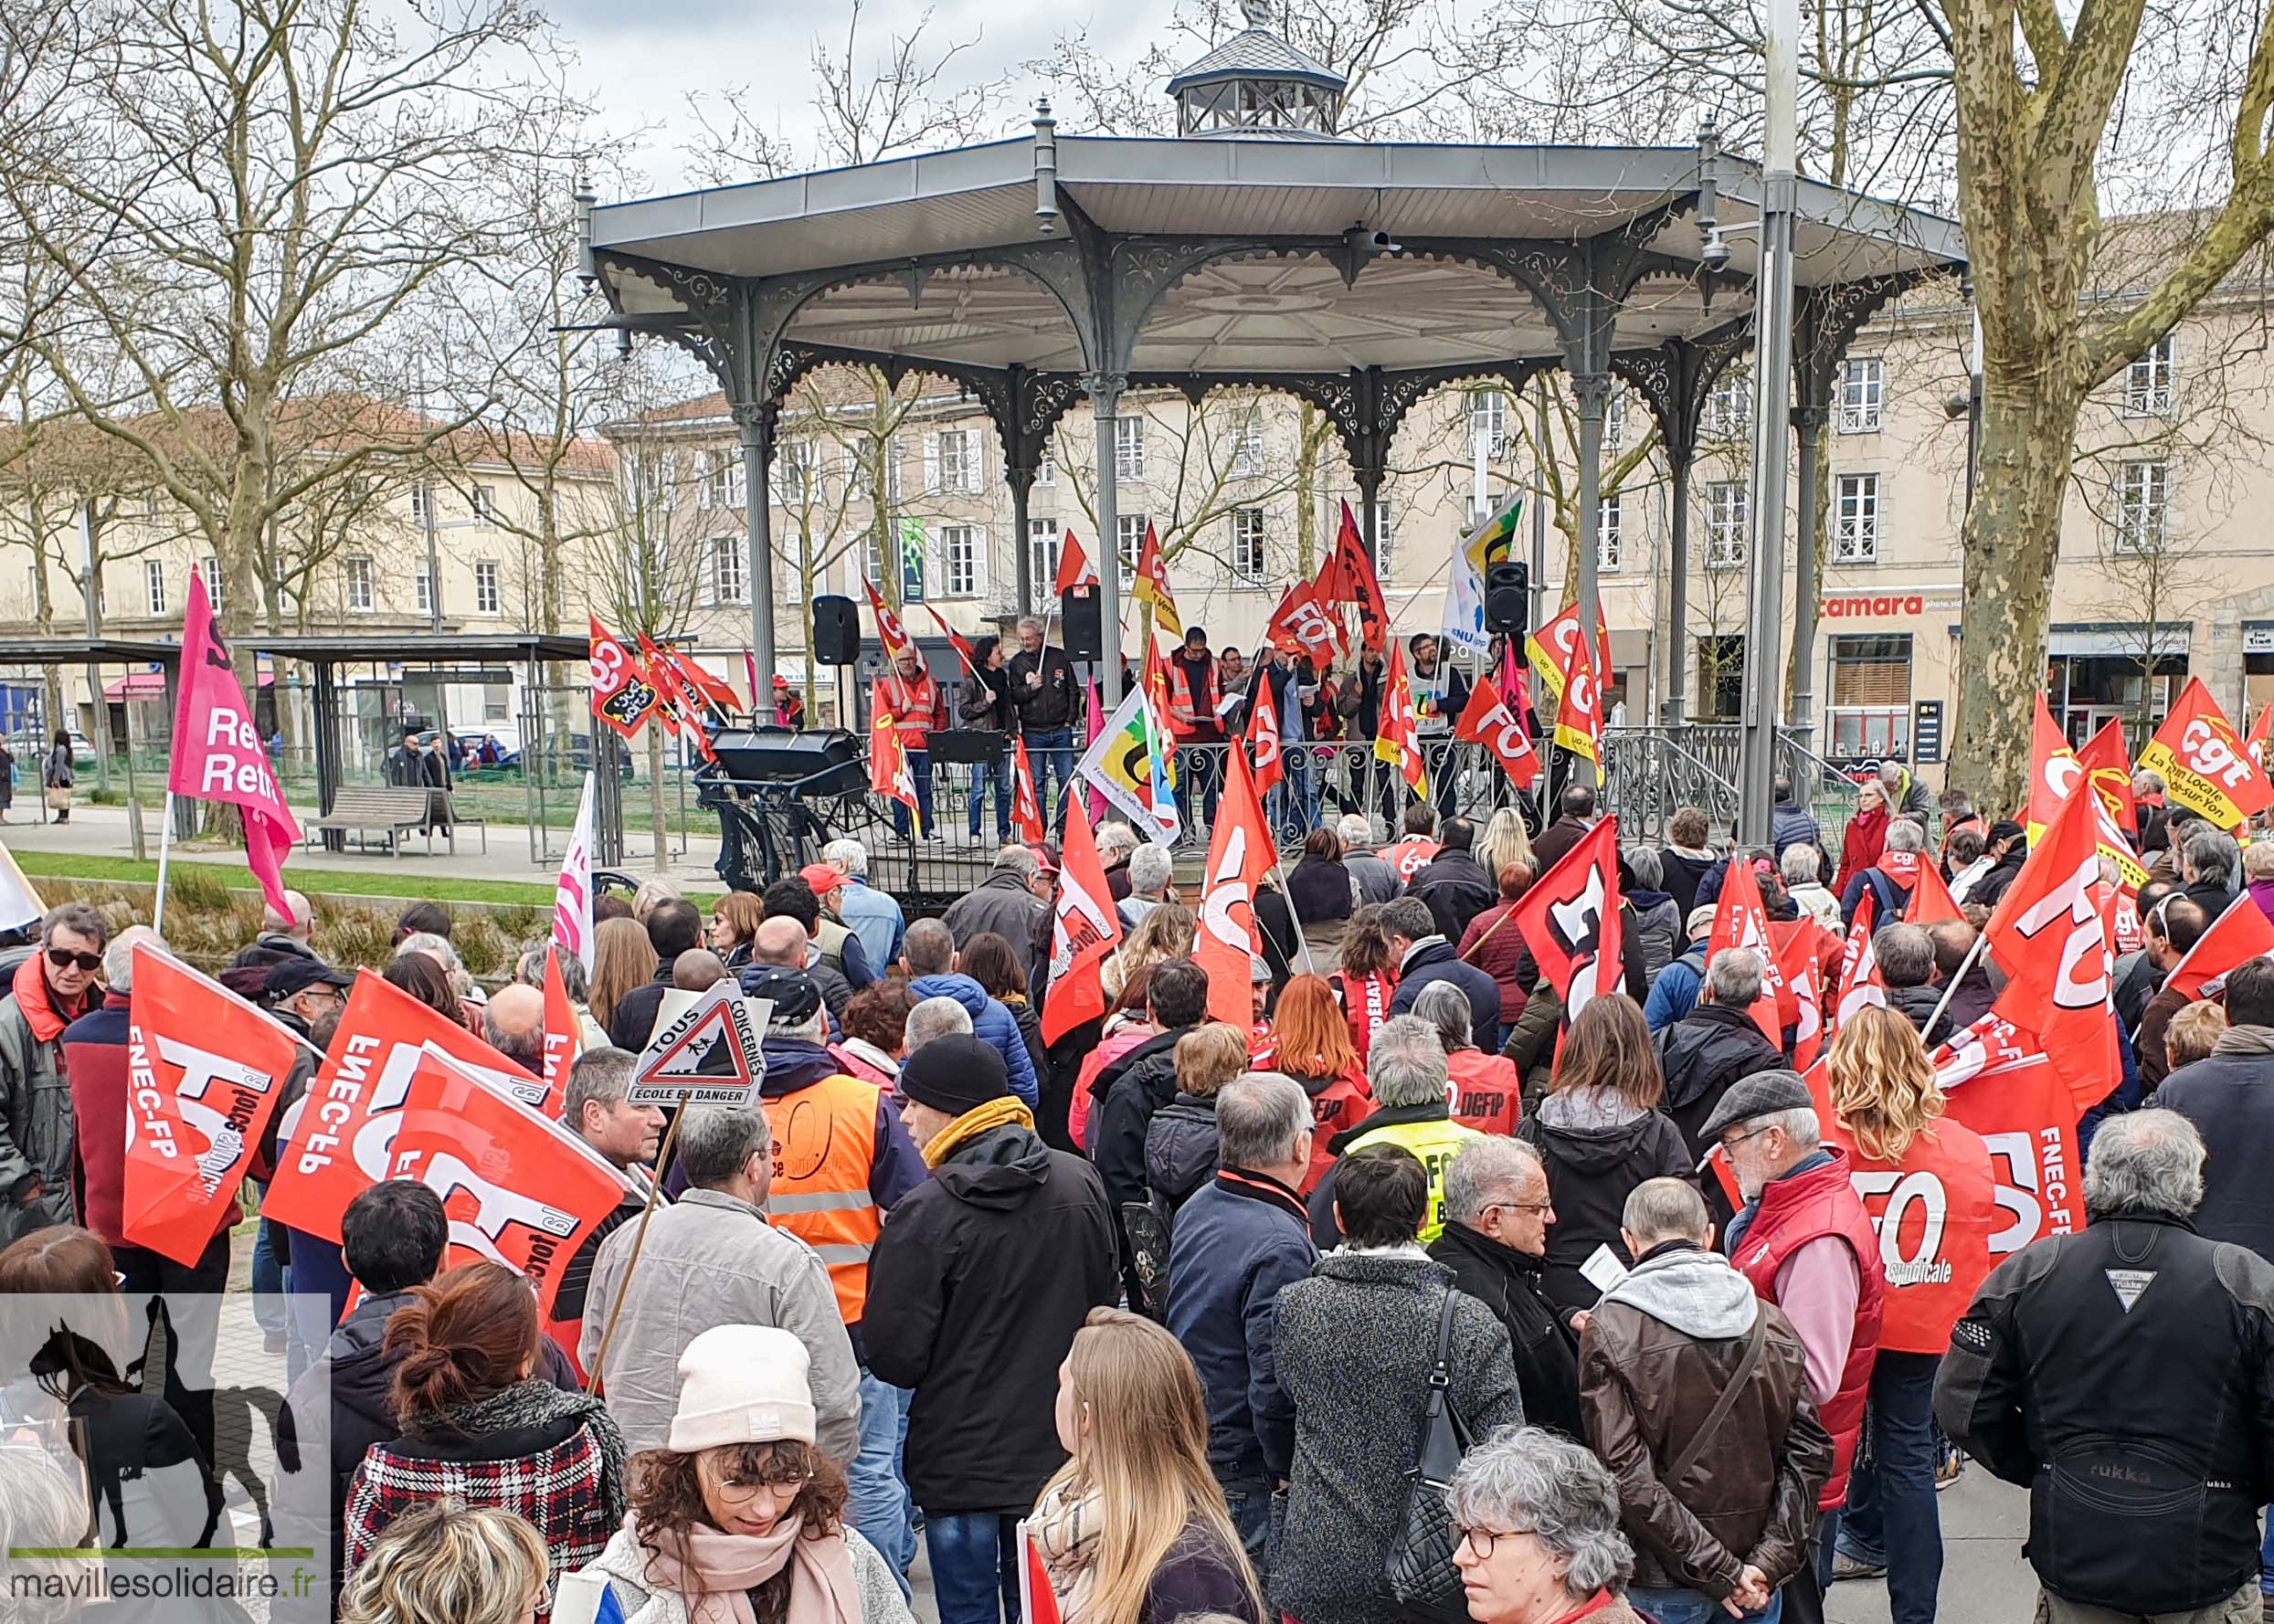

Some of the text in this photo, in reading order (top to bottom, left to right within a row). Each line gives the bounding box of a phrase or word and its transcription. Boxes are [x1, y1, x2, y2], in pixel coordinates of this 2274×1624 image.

[2181, 719, 2253, 789] cgt
[647, 1008, 700, 1056] TOUS
[695, 1091, 744, 1102] DANGER
[1888, 1259, 1952, 1288] syndicale
[2090, 1462, 2151, 1483] rukka
